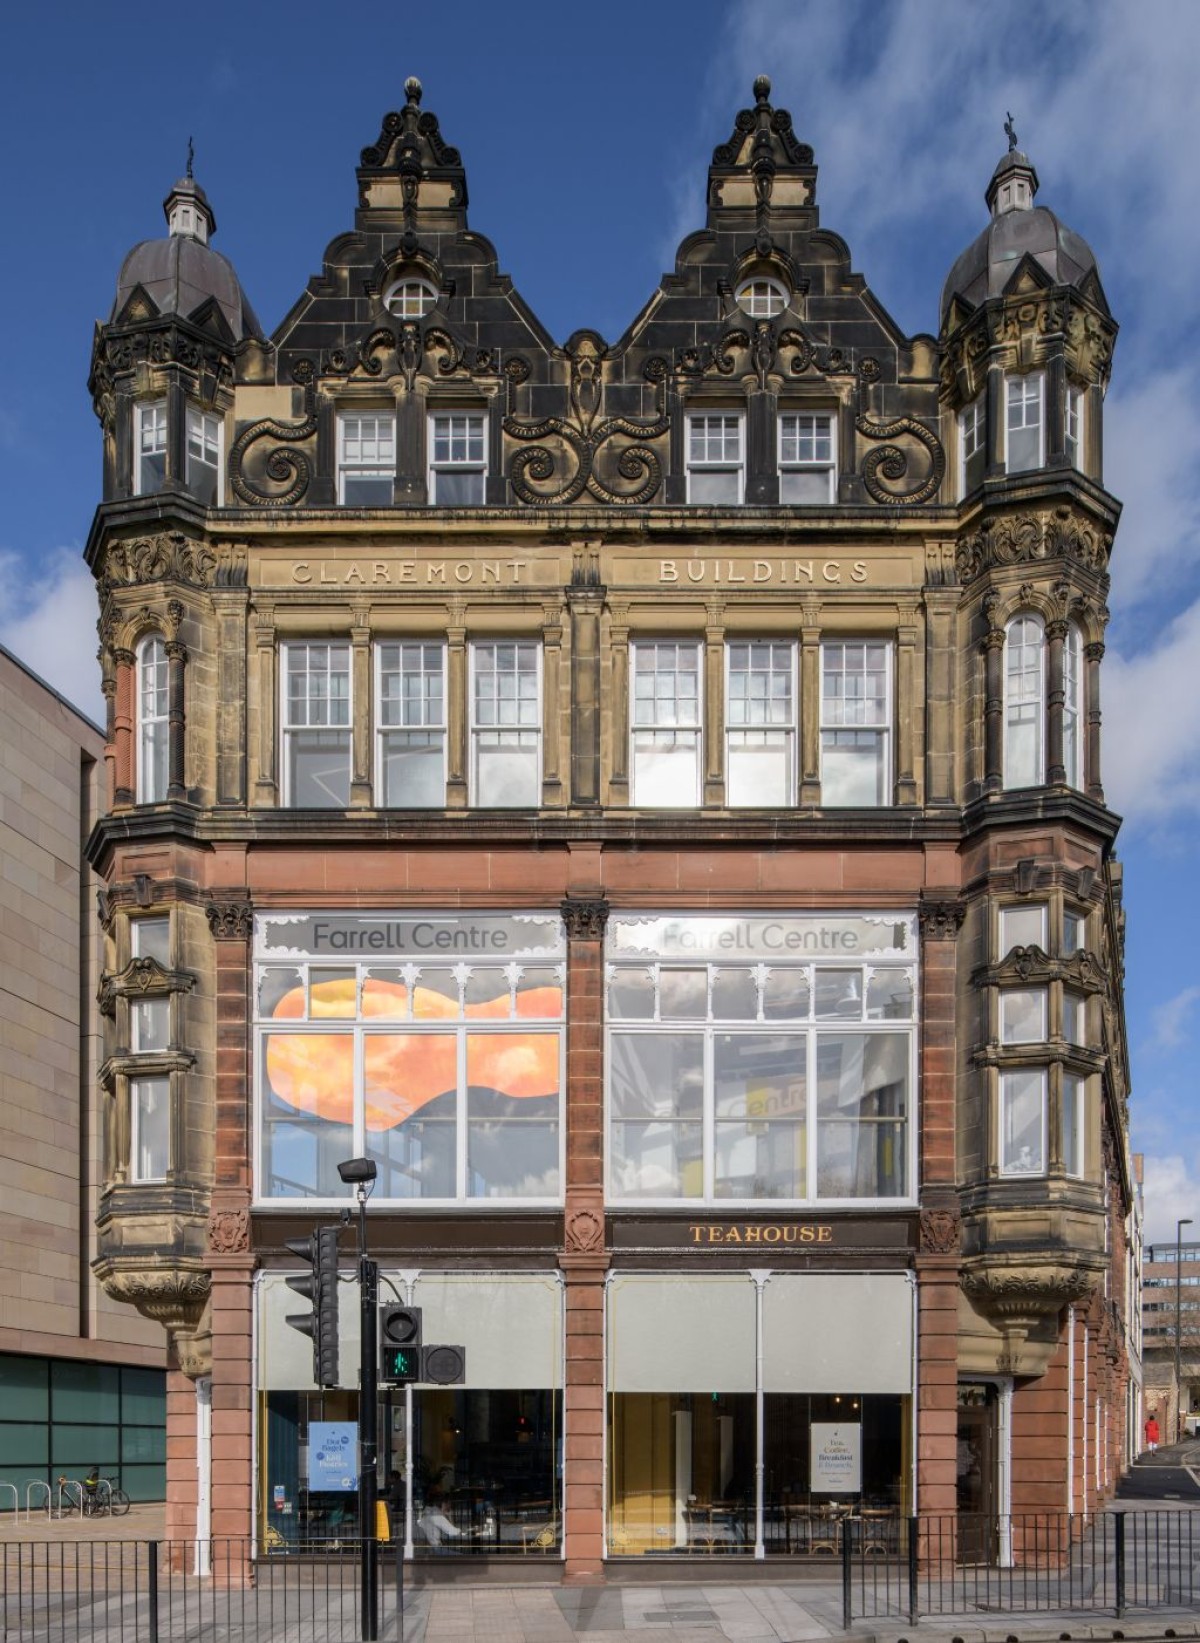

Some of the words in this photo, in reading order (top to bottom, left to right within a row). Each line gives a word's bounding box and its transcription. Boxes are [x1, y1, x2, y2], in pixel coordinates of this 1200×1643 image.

[292, 561, 527, 584] CLAREMONT
[659, 560, 869, 583] BUILDINGS
[314, 923, 404, 948] Farrell
[411, 923, 508, 948] Centre
[663, 923, 753, 948] Farrell
[761, 923, 858, 948] Centre
[689, 1226, 832, 1242] TEAHOUSE
